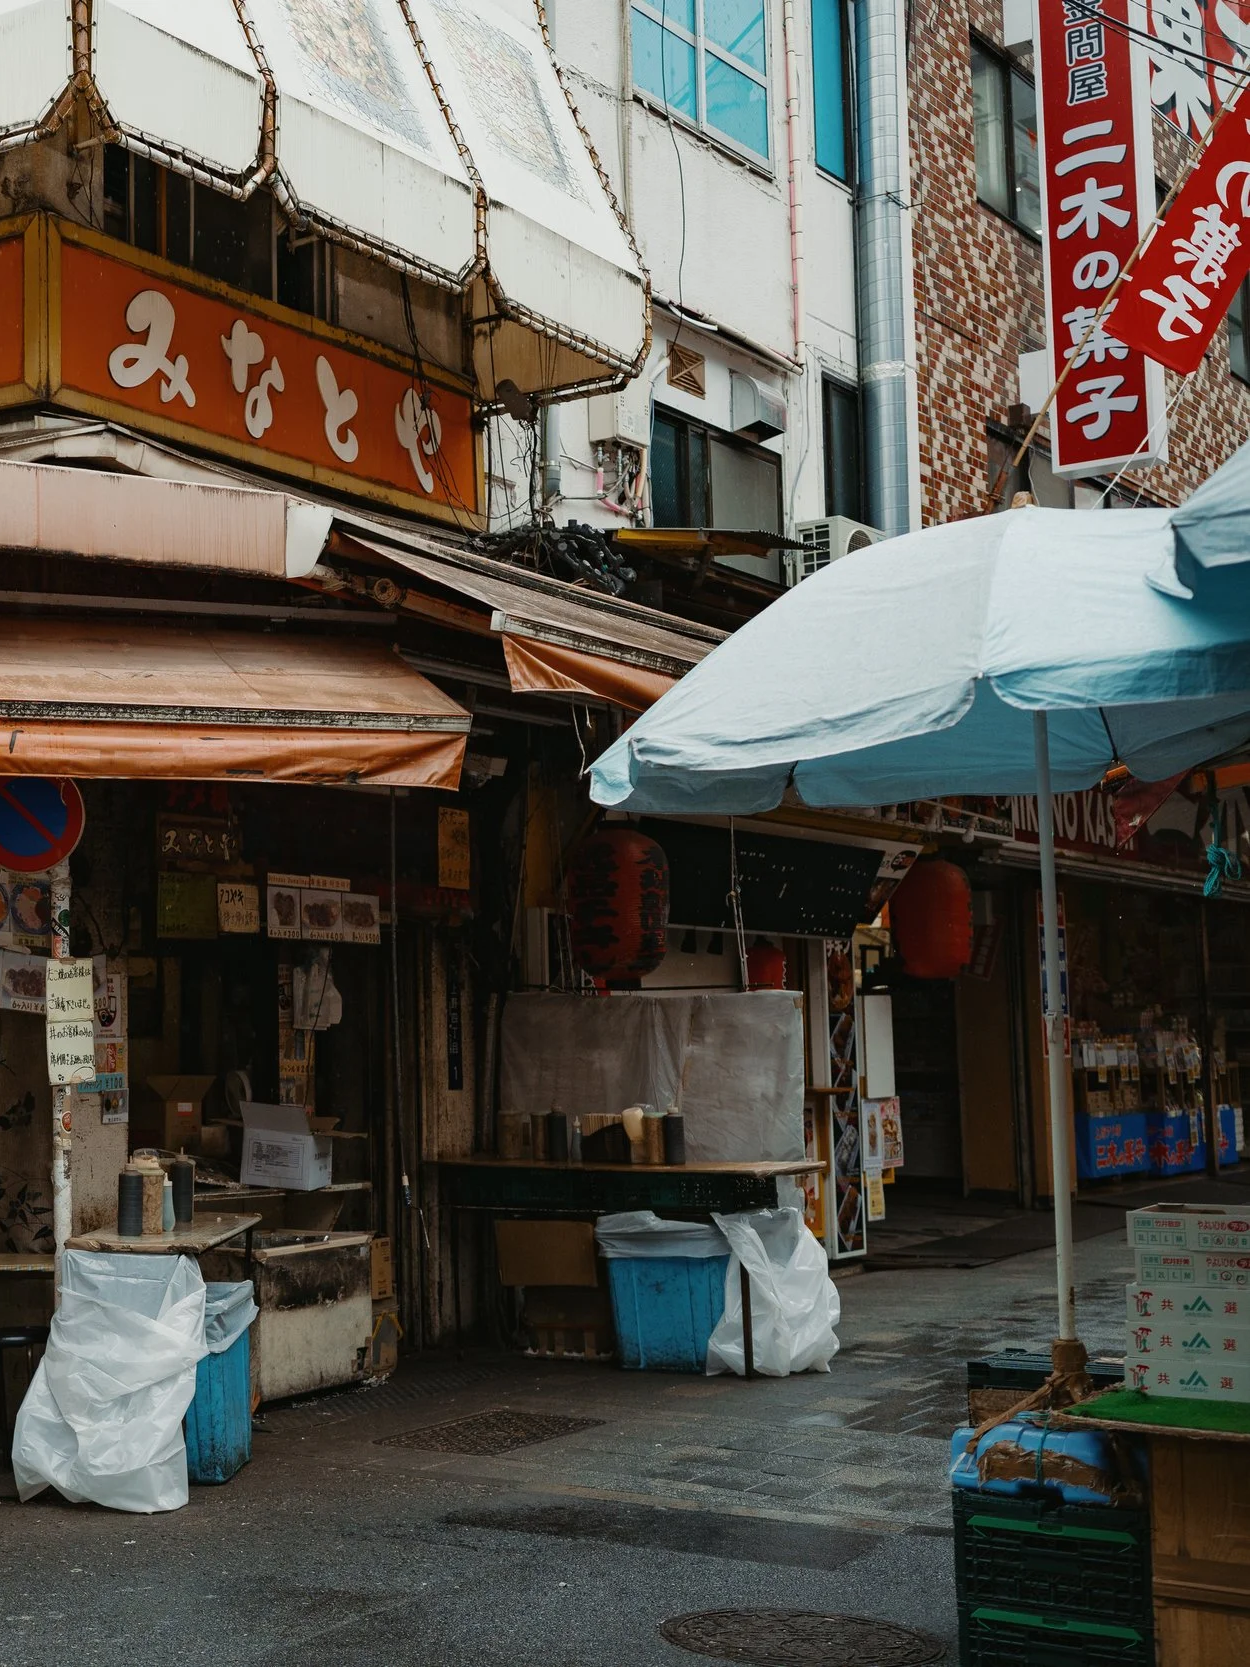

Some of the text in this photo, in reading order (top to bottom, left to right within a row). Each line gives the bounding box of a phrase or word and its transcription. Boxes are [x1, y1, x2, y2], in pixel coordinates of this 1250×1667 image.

[1054, 120, 1139, 442] 二木の菓子
[109, 290, 442, 494] みなとや
[1161, 1298, 1174, 1311] 共
[1224, 1301, 1238, 1314] 選
[1160, 1334, 1173, 1347] 共
[1223, 1338, 1237, 1351] 選
[1157, 1372, 1170, 1385] 共
[1220, 1376, 1234, 1390] 選
